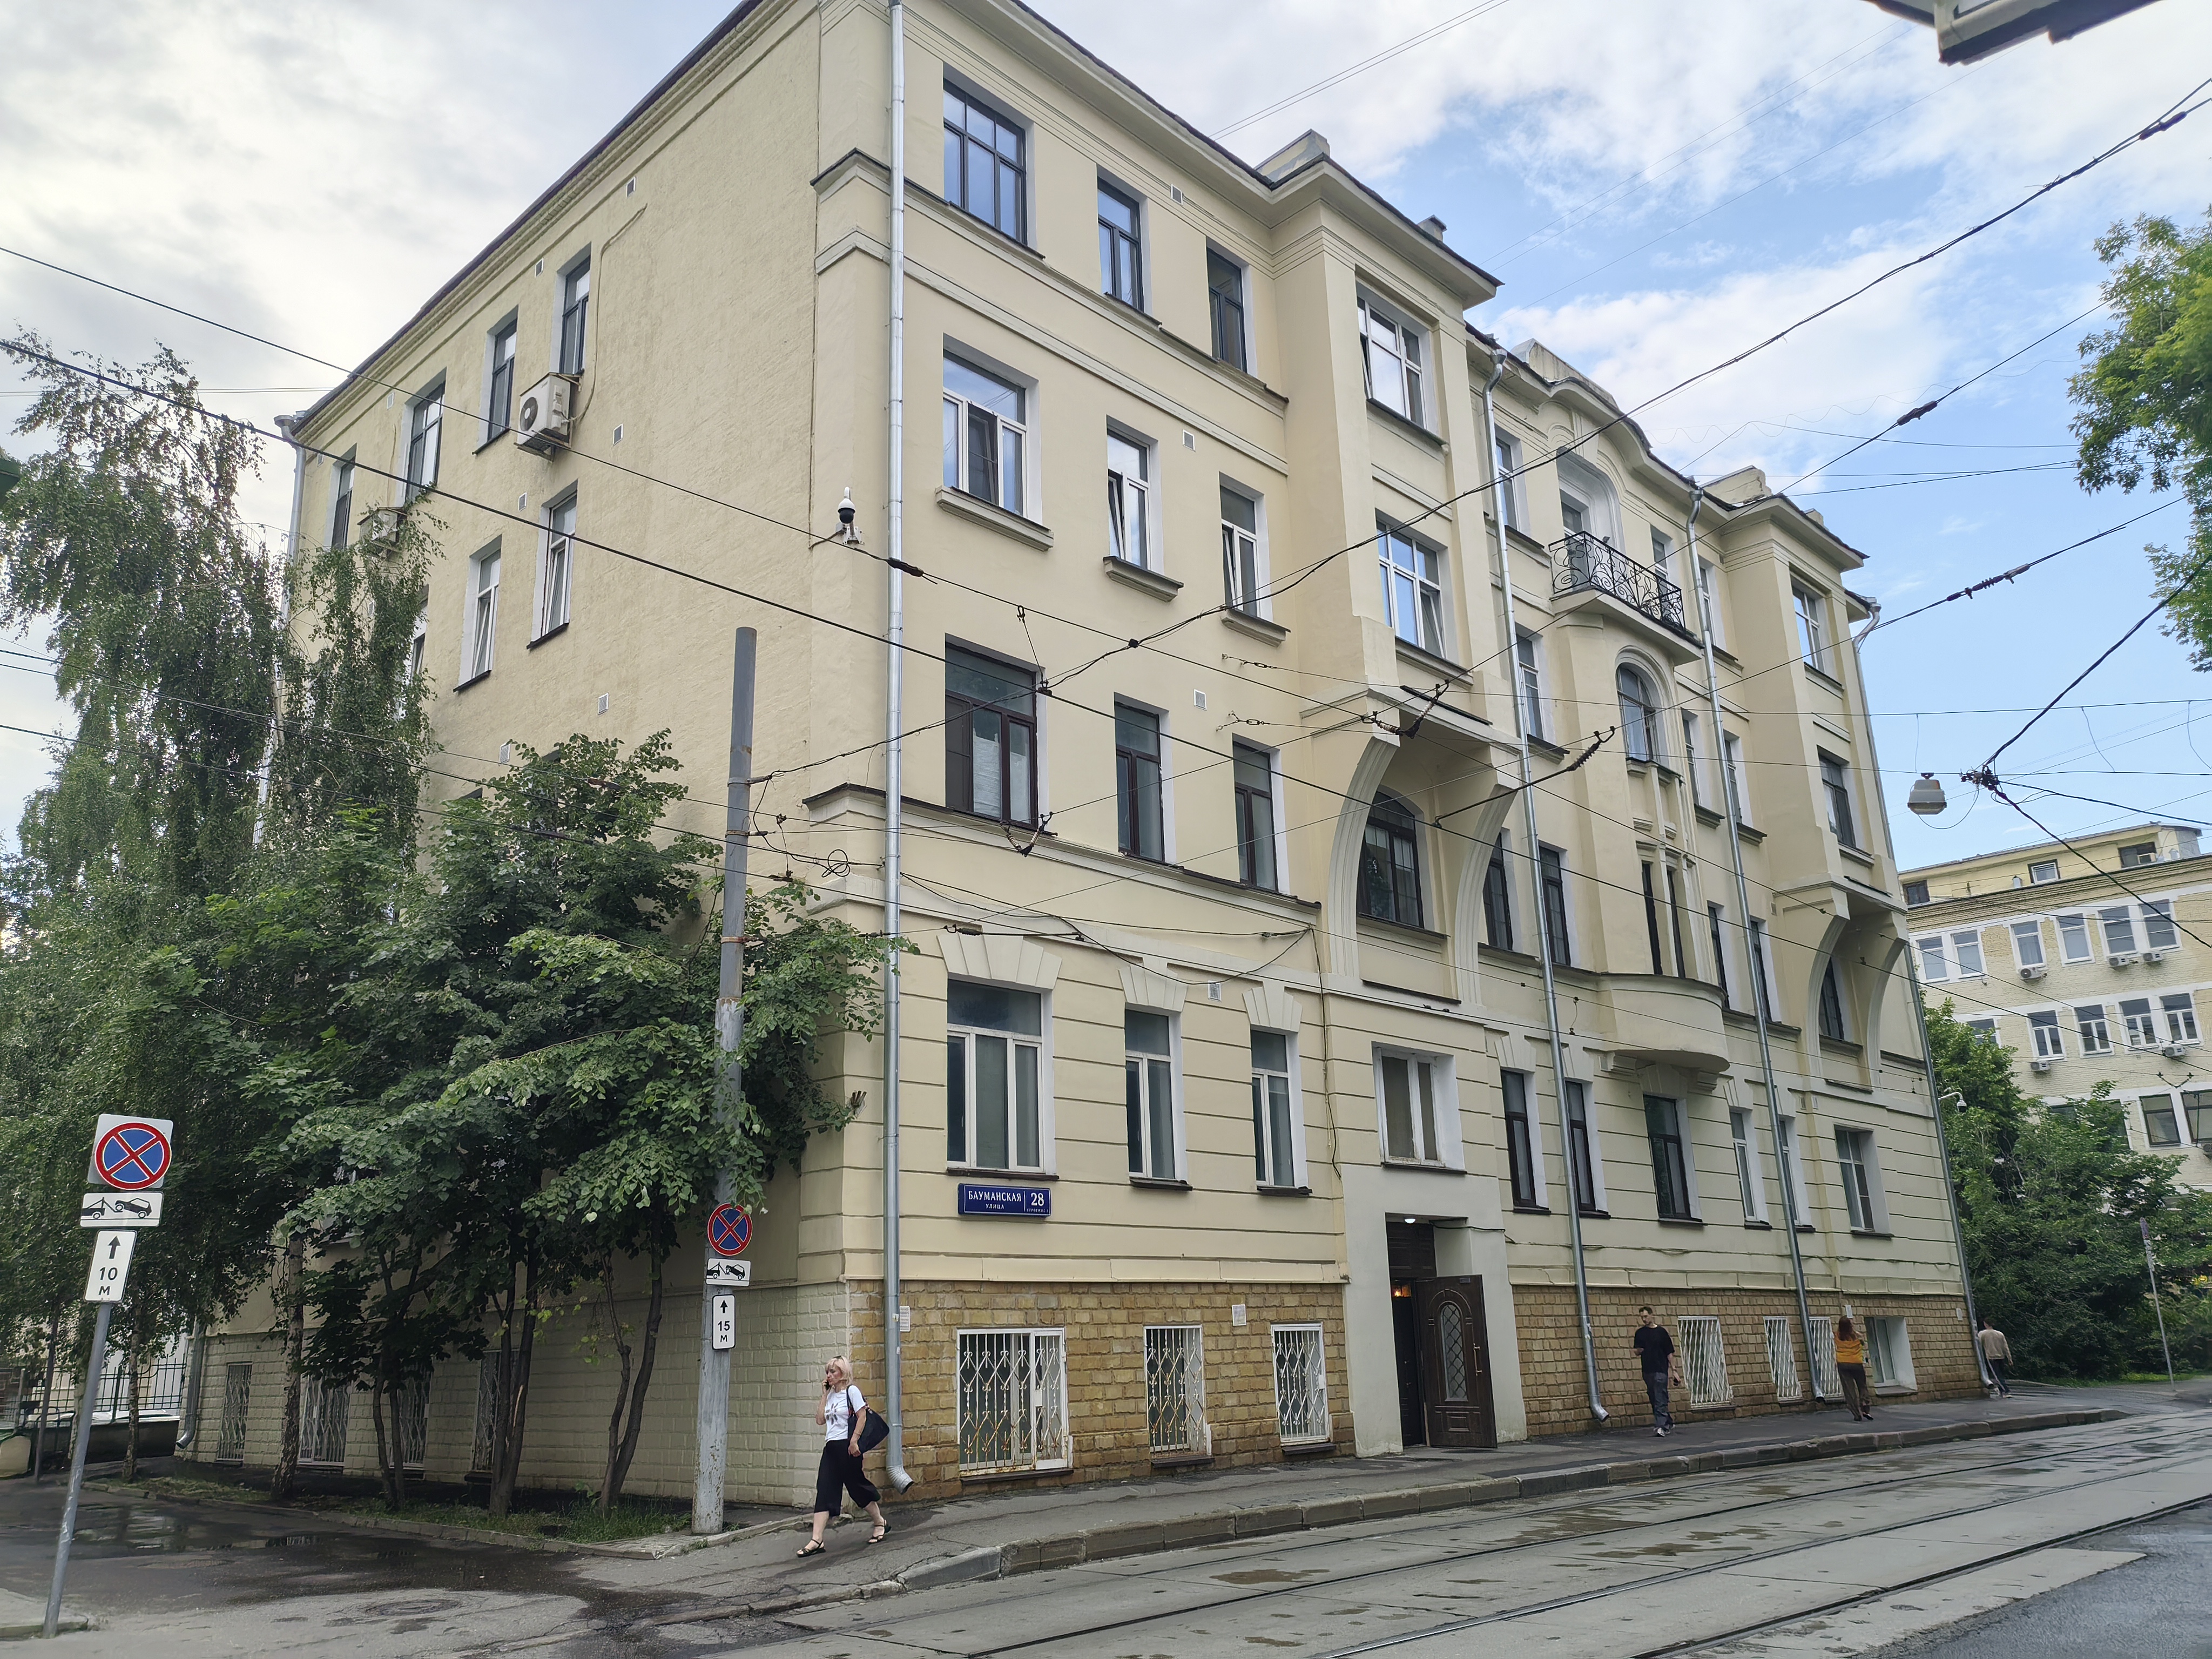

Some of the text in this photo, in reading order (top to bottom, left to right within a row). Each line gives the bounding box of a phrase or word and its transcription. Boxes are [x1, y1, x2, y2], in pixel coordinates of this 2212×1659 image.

[968, 1191, 1021, 1202] БАУМАНСКАЯ
[1031, 1192, 1044, 1206] 28
[99, 1266, 118, 1280] 10
[718, 1320, 730, 1331] 15
